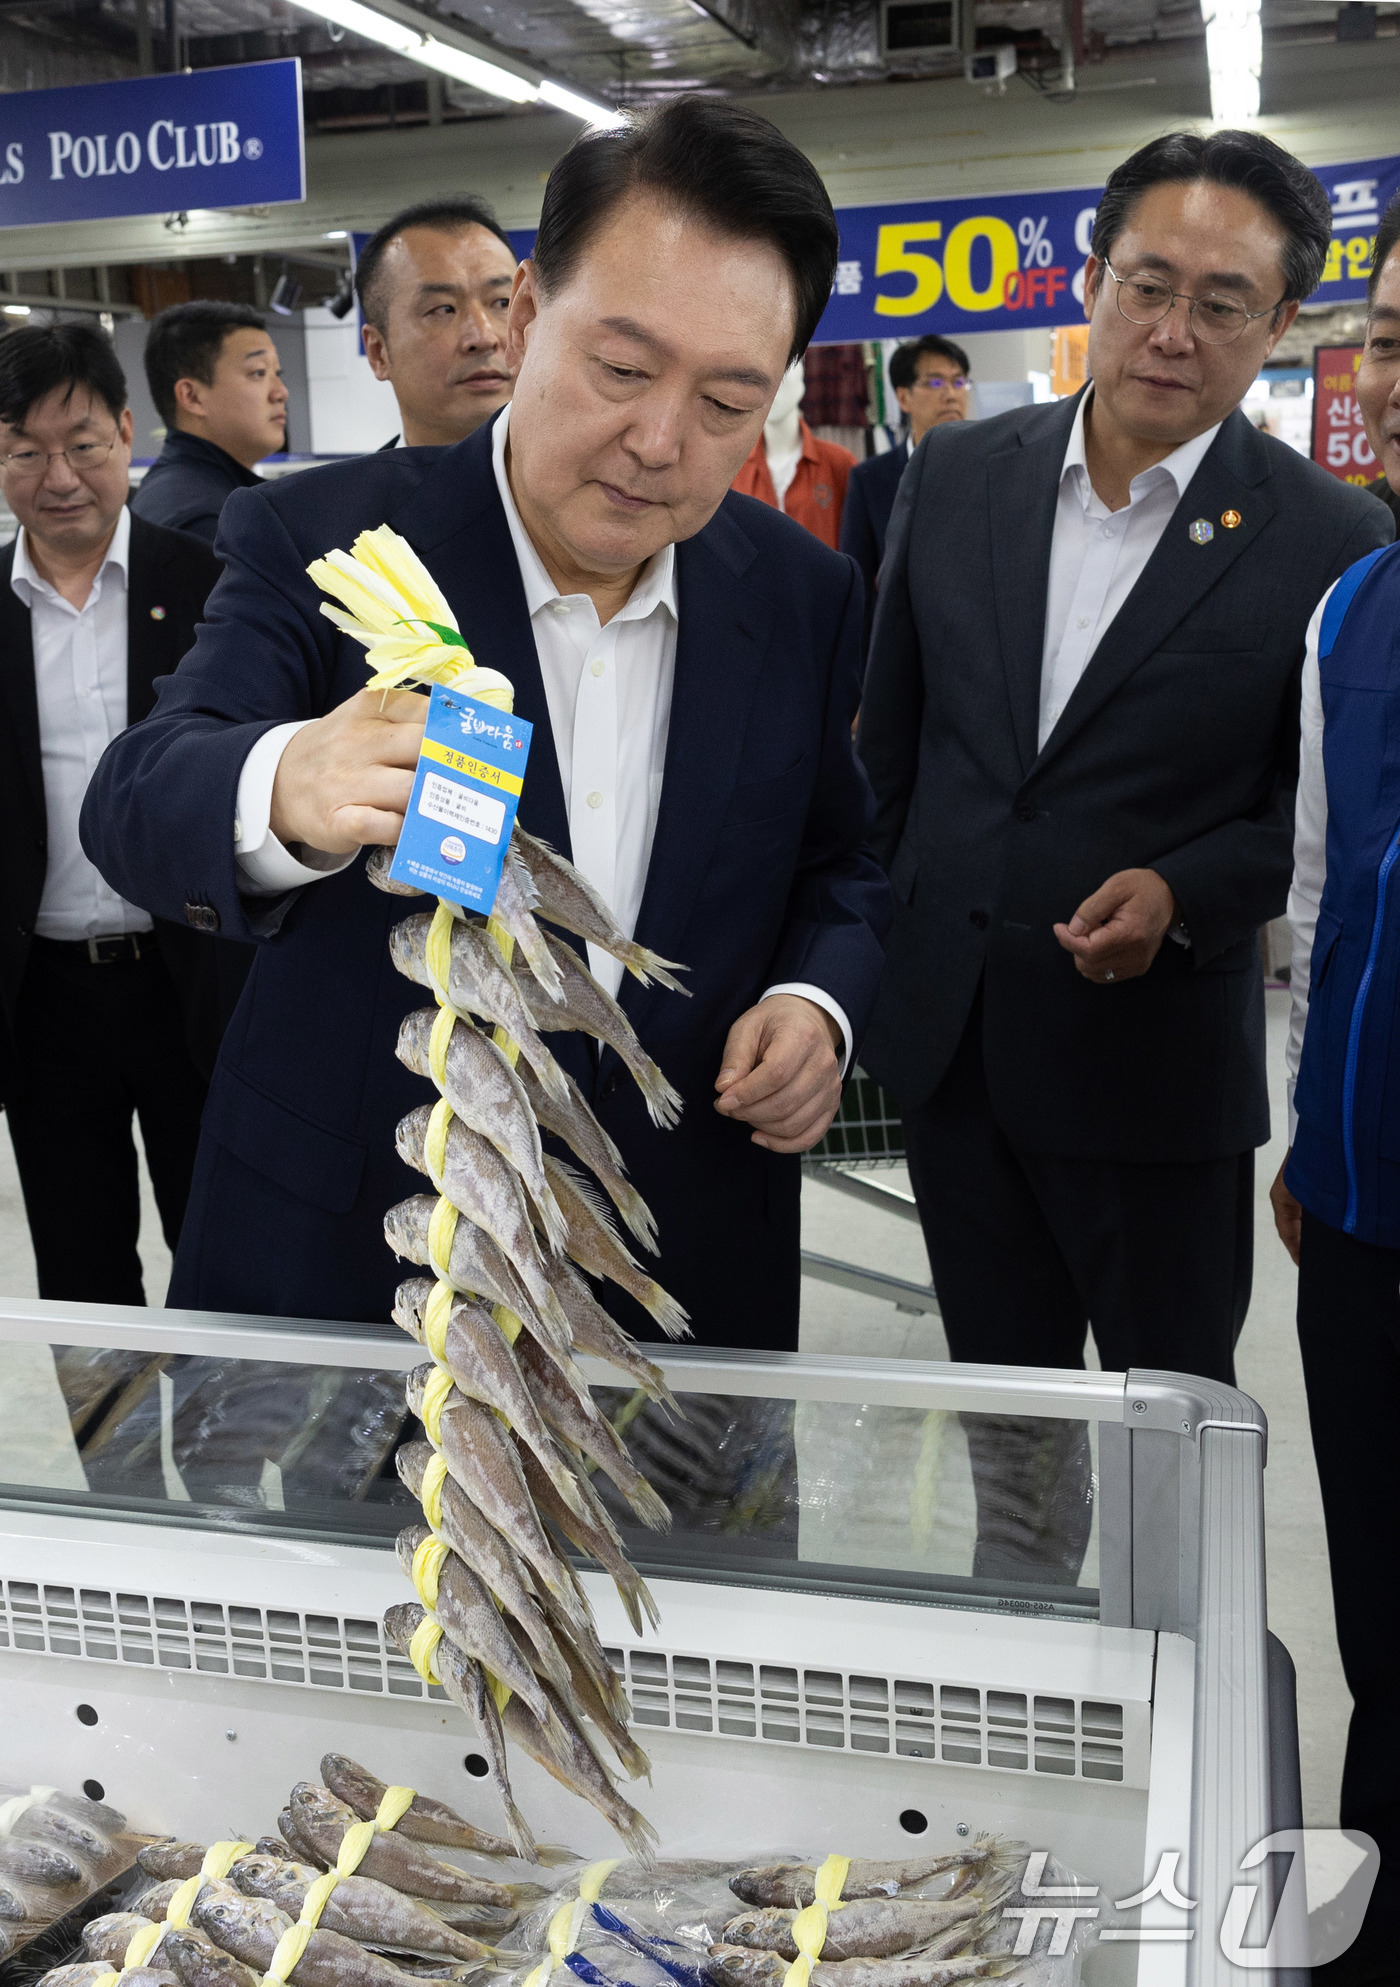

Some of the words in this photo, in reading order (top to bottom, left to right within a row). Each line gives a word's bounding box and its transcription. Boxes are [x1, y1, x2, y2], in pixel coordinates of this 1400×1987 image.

[0, 143, 24, 185] S
[48, 131, 141, 180] POLO
[1003, 266, 1067, 311] OFF
[444, 750, 501, 785] 정품인증서
